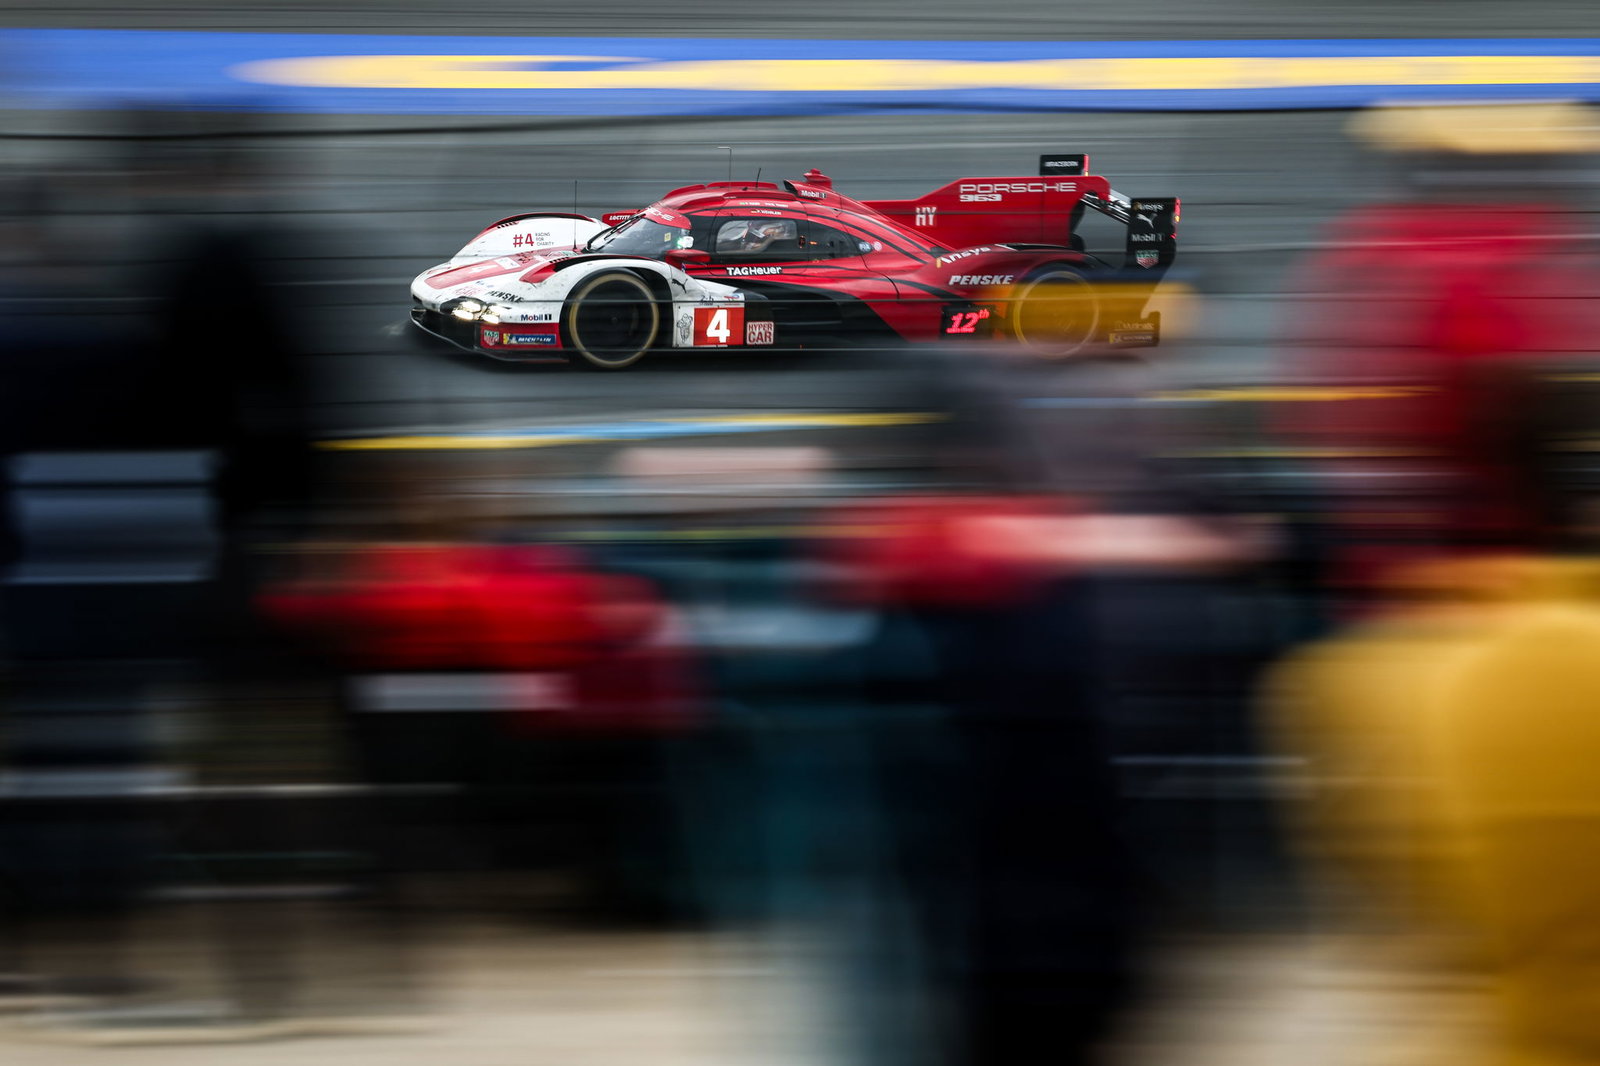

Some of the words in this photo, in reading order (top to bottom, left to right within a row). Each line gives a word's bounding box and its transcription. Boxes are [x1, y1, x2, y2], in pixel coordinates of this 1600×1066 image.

[959, 182, 1077, 194] PORSCHE
[959, 194, 1002, 202] 963
[513, 233, 534, 247] #4
[949, 275, 1014, 285] PENSKE
[706, 309, 730, 343] 4
[748, 323, 773, 331] HYPER
[748, 331, 773, 343] CAR
